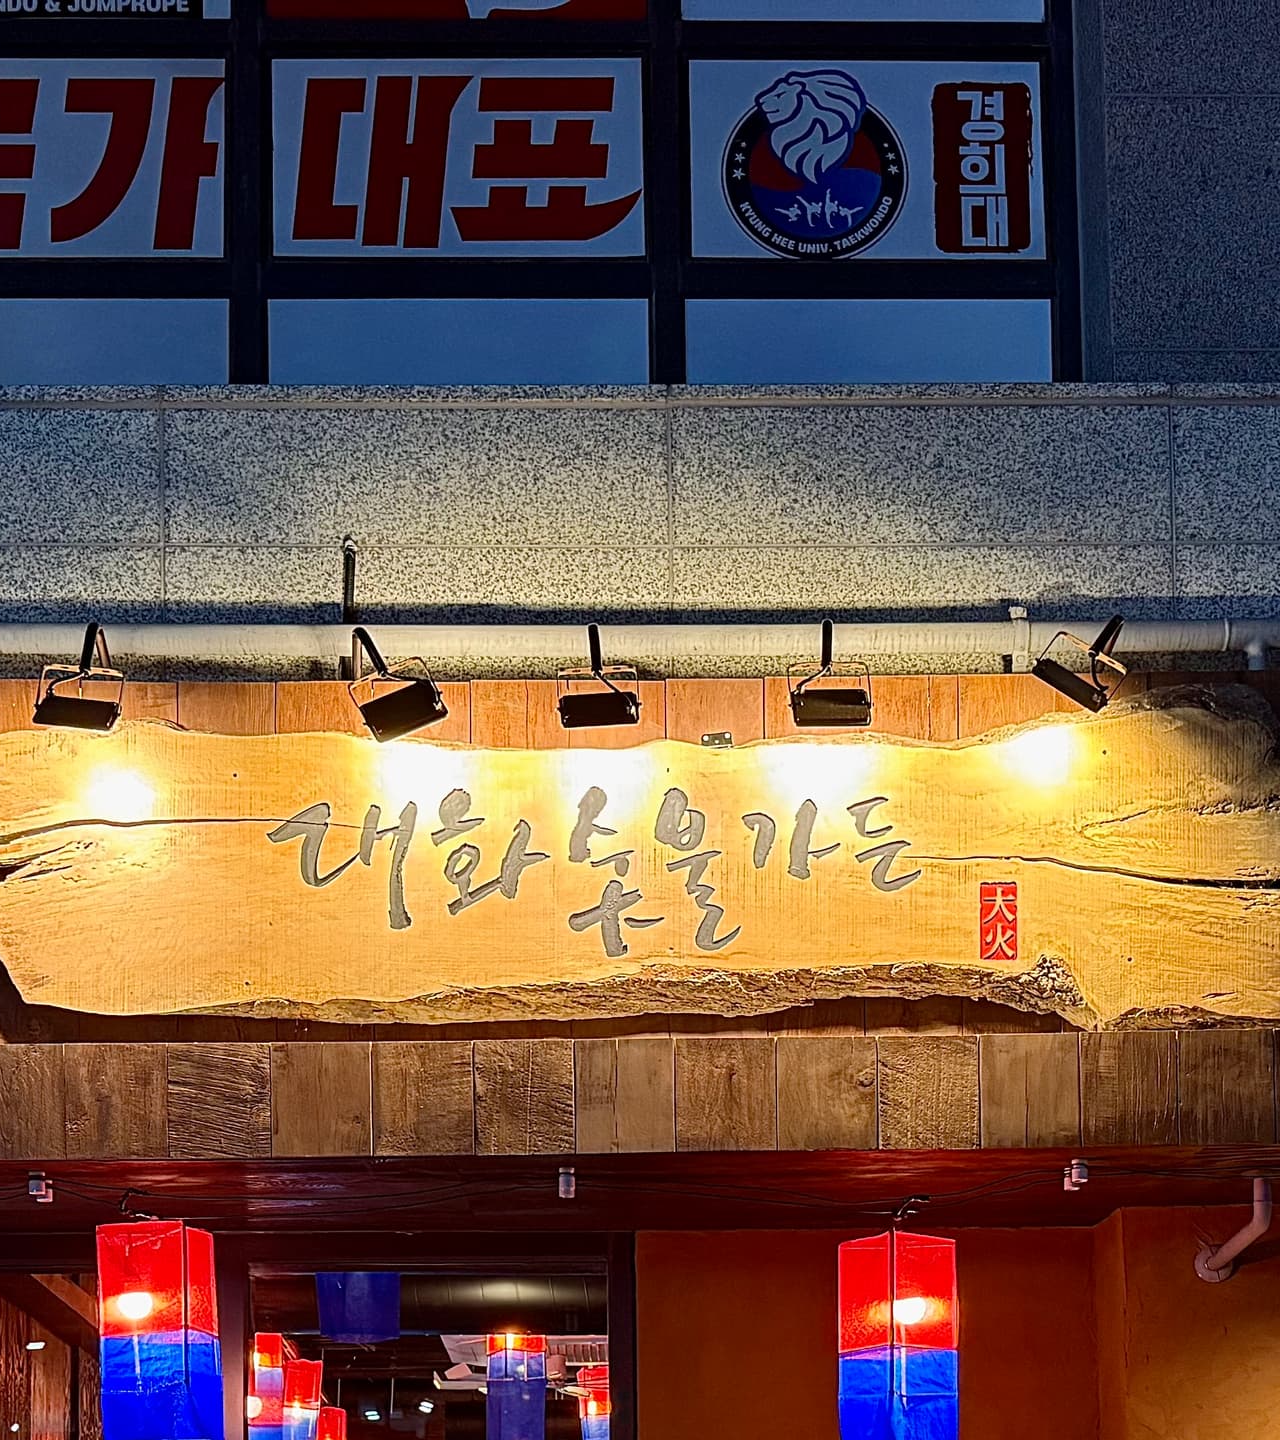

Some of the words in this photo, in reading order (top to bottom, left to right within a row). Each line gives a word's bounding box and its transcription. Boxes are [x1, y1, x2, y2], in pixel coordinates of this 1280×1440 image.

[957, 90, 1009, 247] 경희대
[739, 201, 771, 240] KYUNG
[771, 232, 796, 251] HEE
[835, 195, 894, 251] TAEKWONDO
